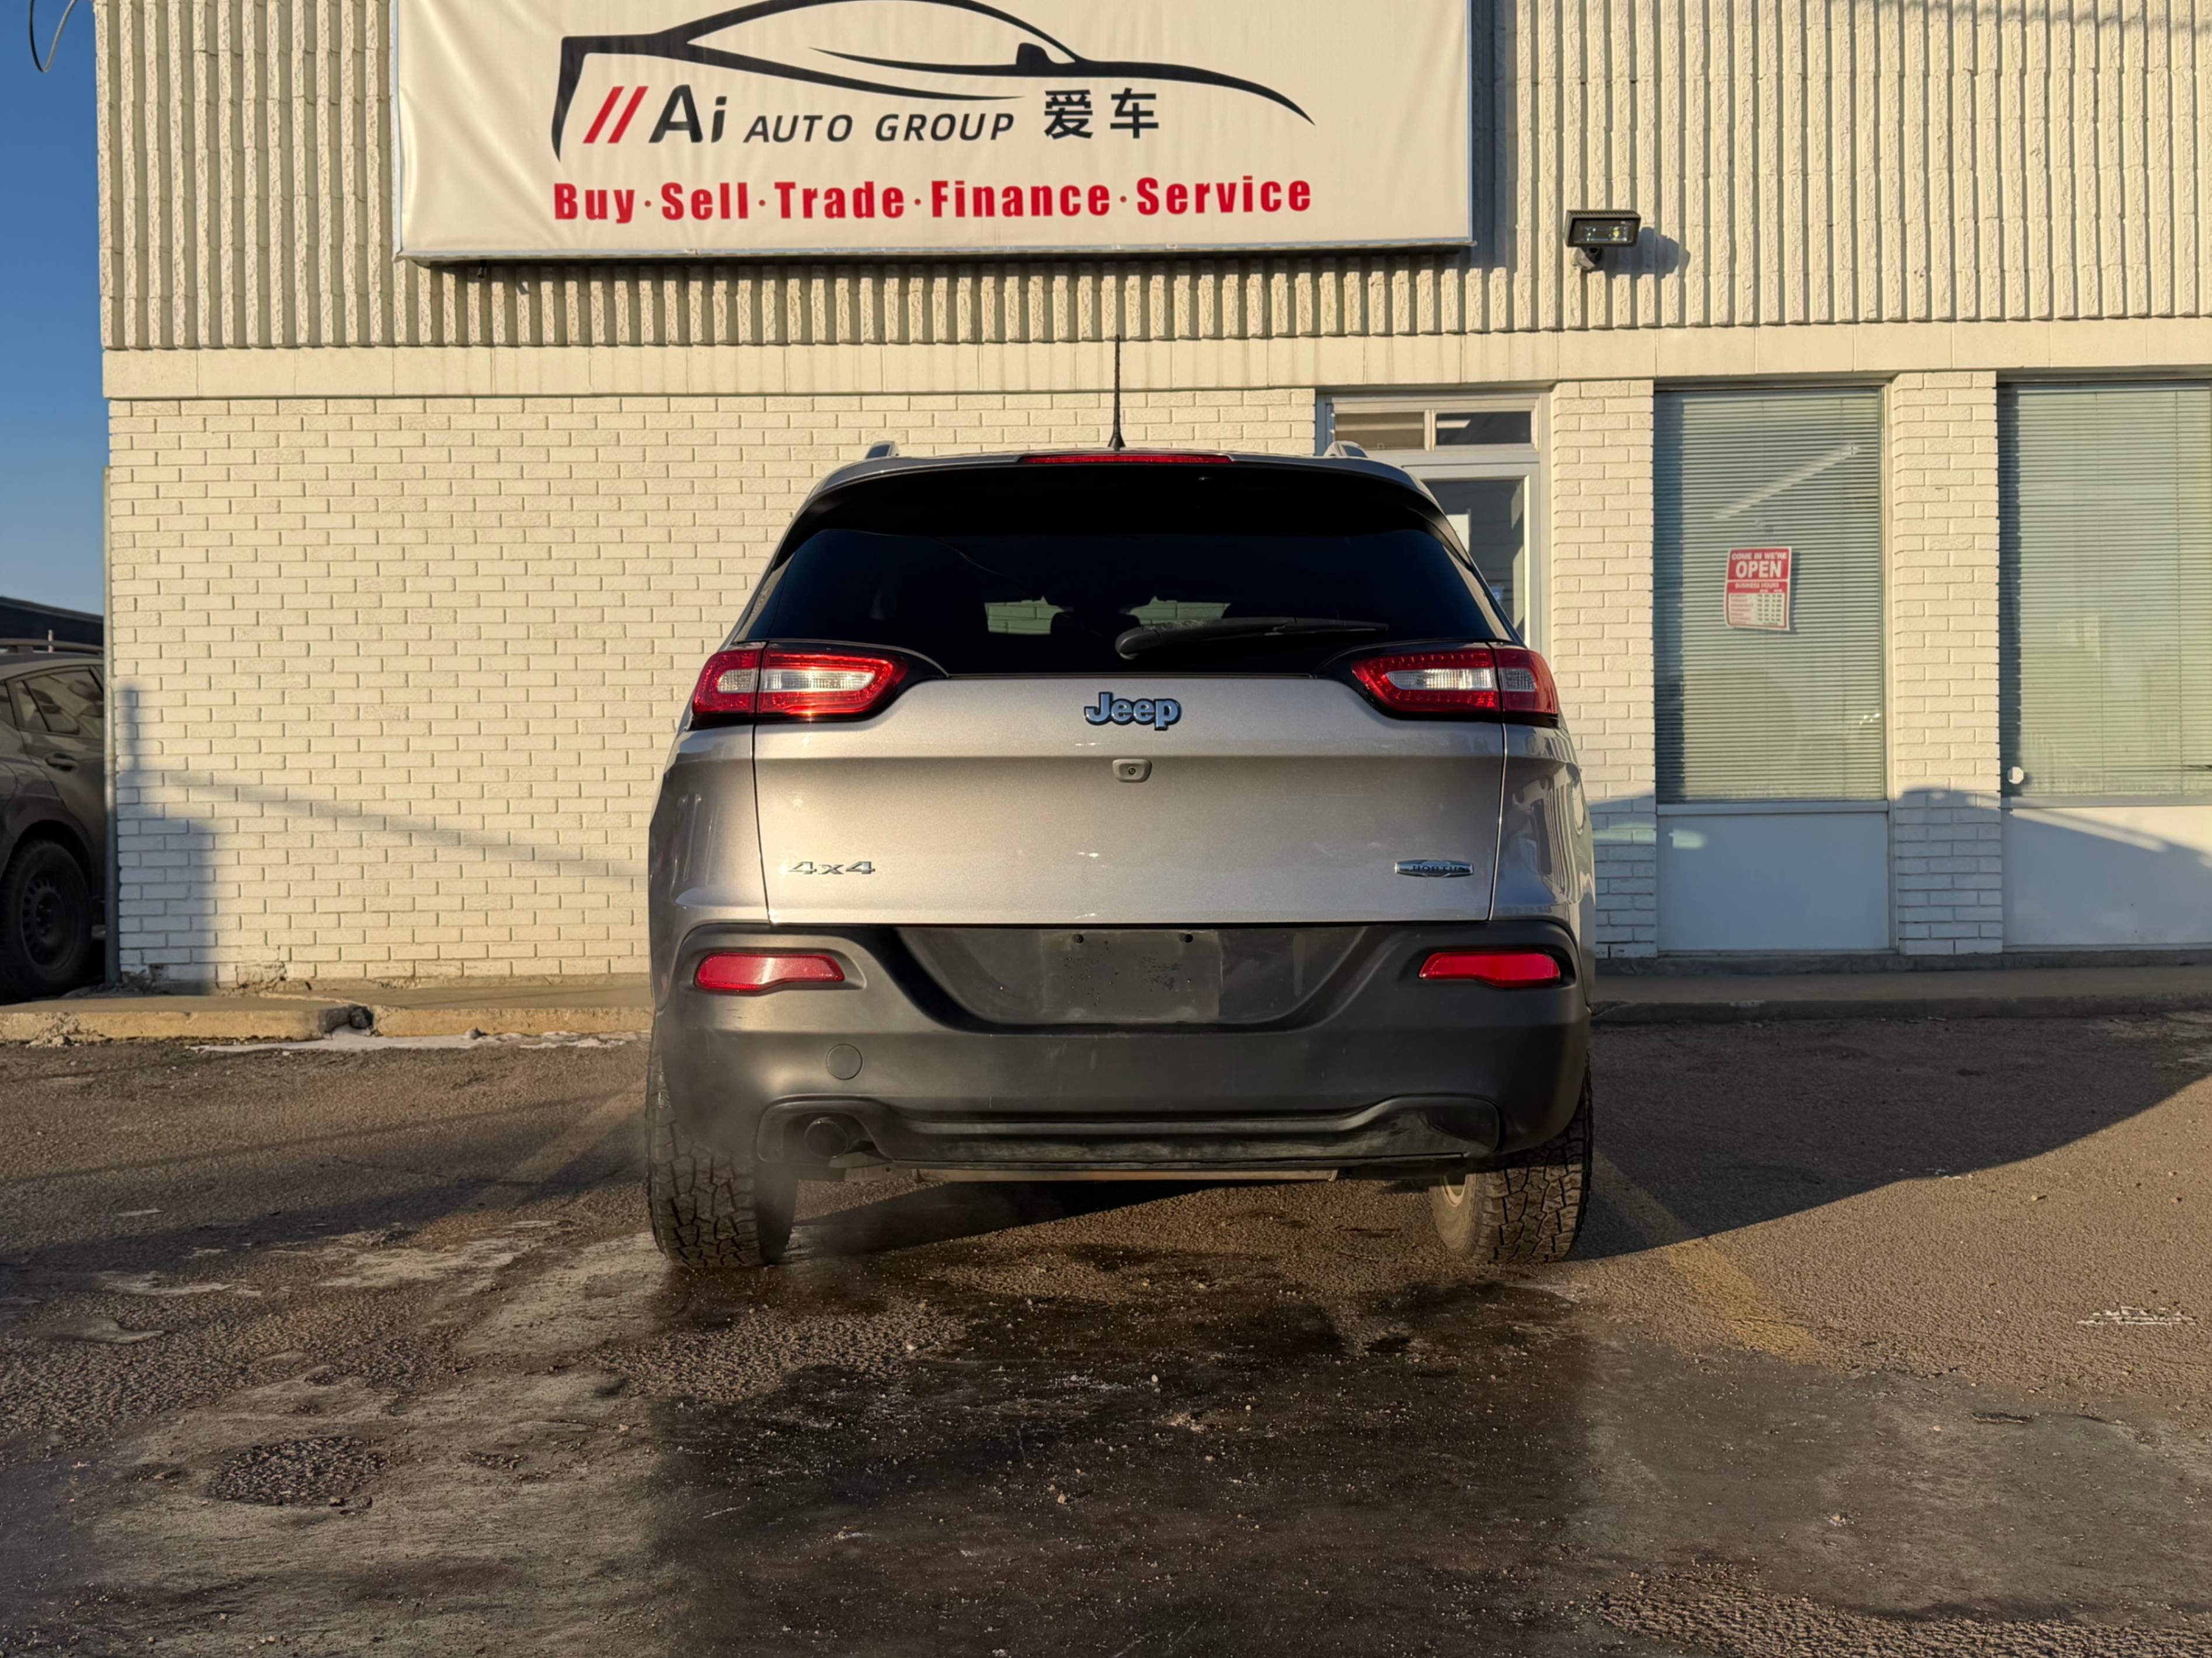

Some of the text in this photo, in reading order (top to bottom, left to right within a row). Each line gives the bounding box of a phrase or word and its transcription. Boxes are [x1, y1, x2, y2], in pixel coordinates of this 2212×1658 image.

[744, 115, 852, 143] AUTO
[876, 113, 1014, 141] GROUP
[1044, 88, 1159, 140] 爱车
[554, 175, 1311, 224] Buy Sell Trade Finance Service
[1735, 560, 1782, 578] OPEN
[1084, 692, 1182, 731] Jeep
[788, 861, 876, 875] 4x4
